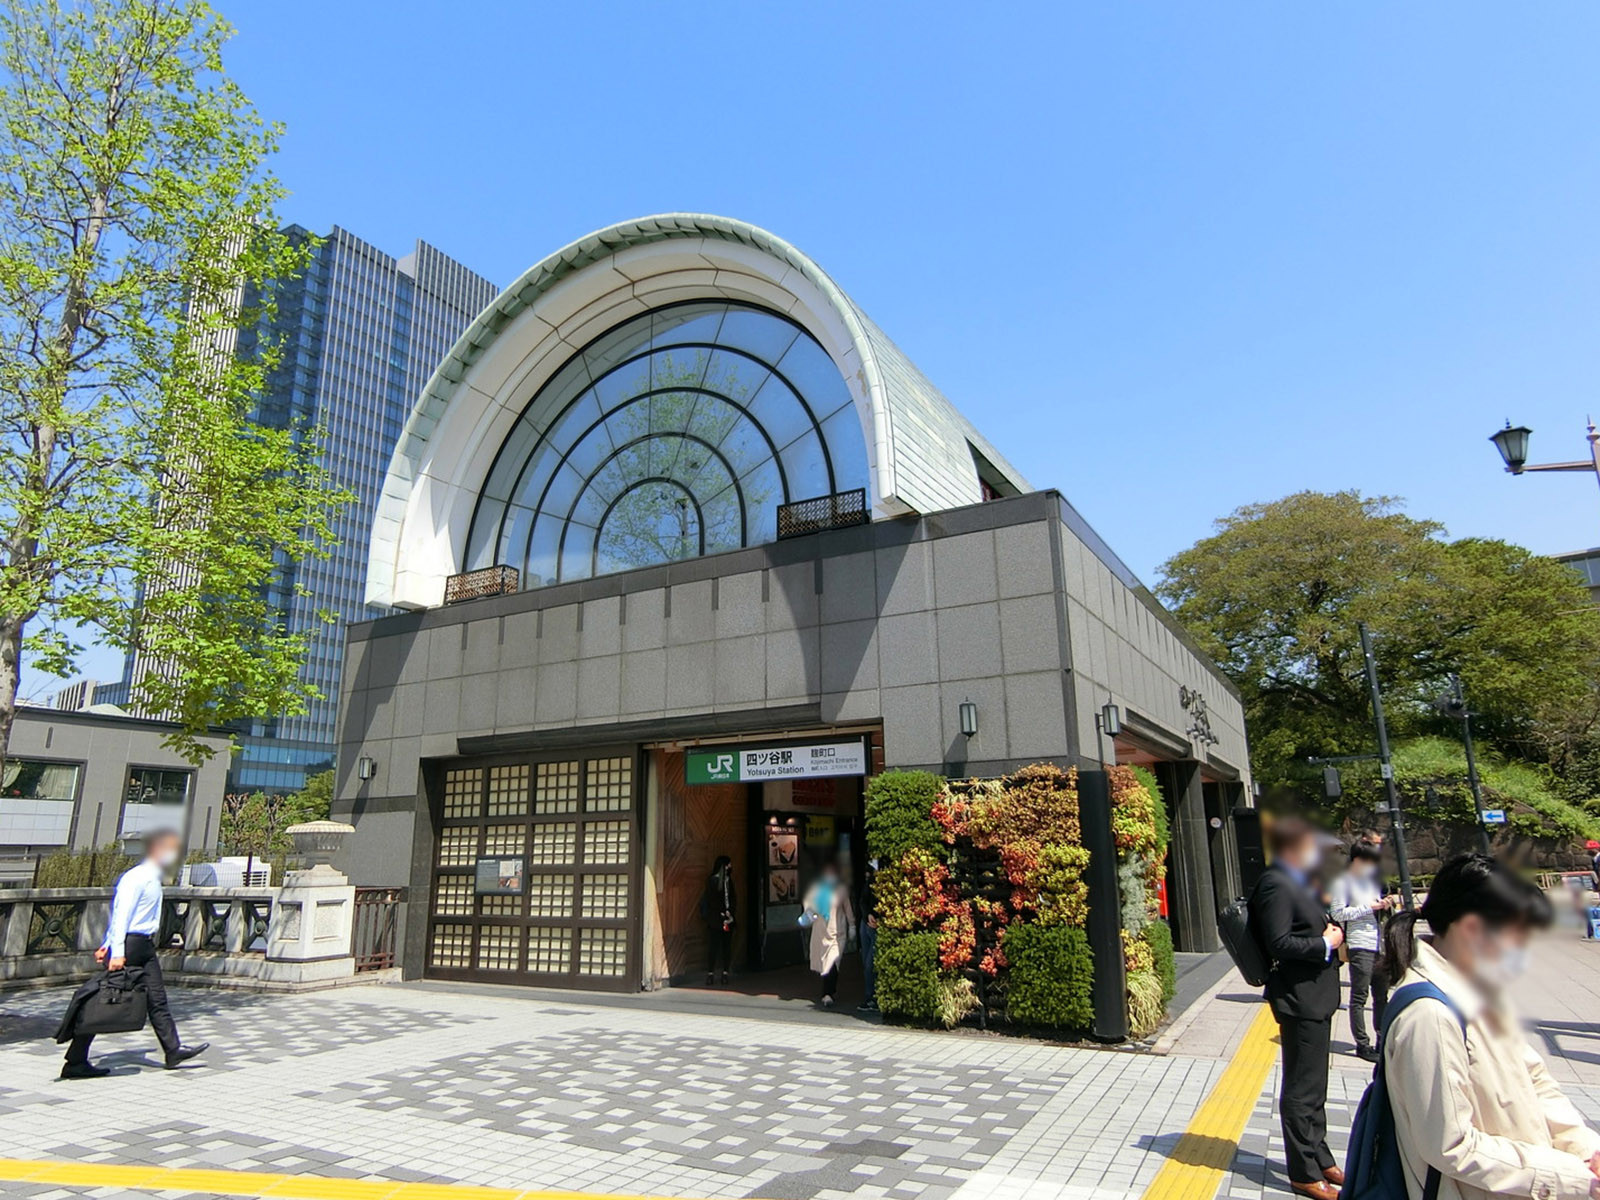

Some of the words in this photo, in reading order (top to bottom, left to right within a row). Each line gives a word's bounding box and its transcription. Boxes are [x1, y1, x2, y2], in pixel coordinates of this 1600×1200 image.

[707, 754, 733, 773] JR
[746, 751, 793, 766] 四ツ谷駅
[747, 768, 776, 777] Yotsuya
[777, 766, 804, 775] Station
